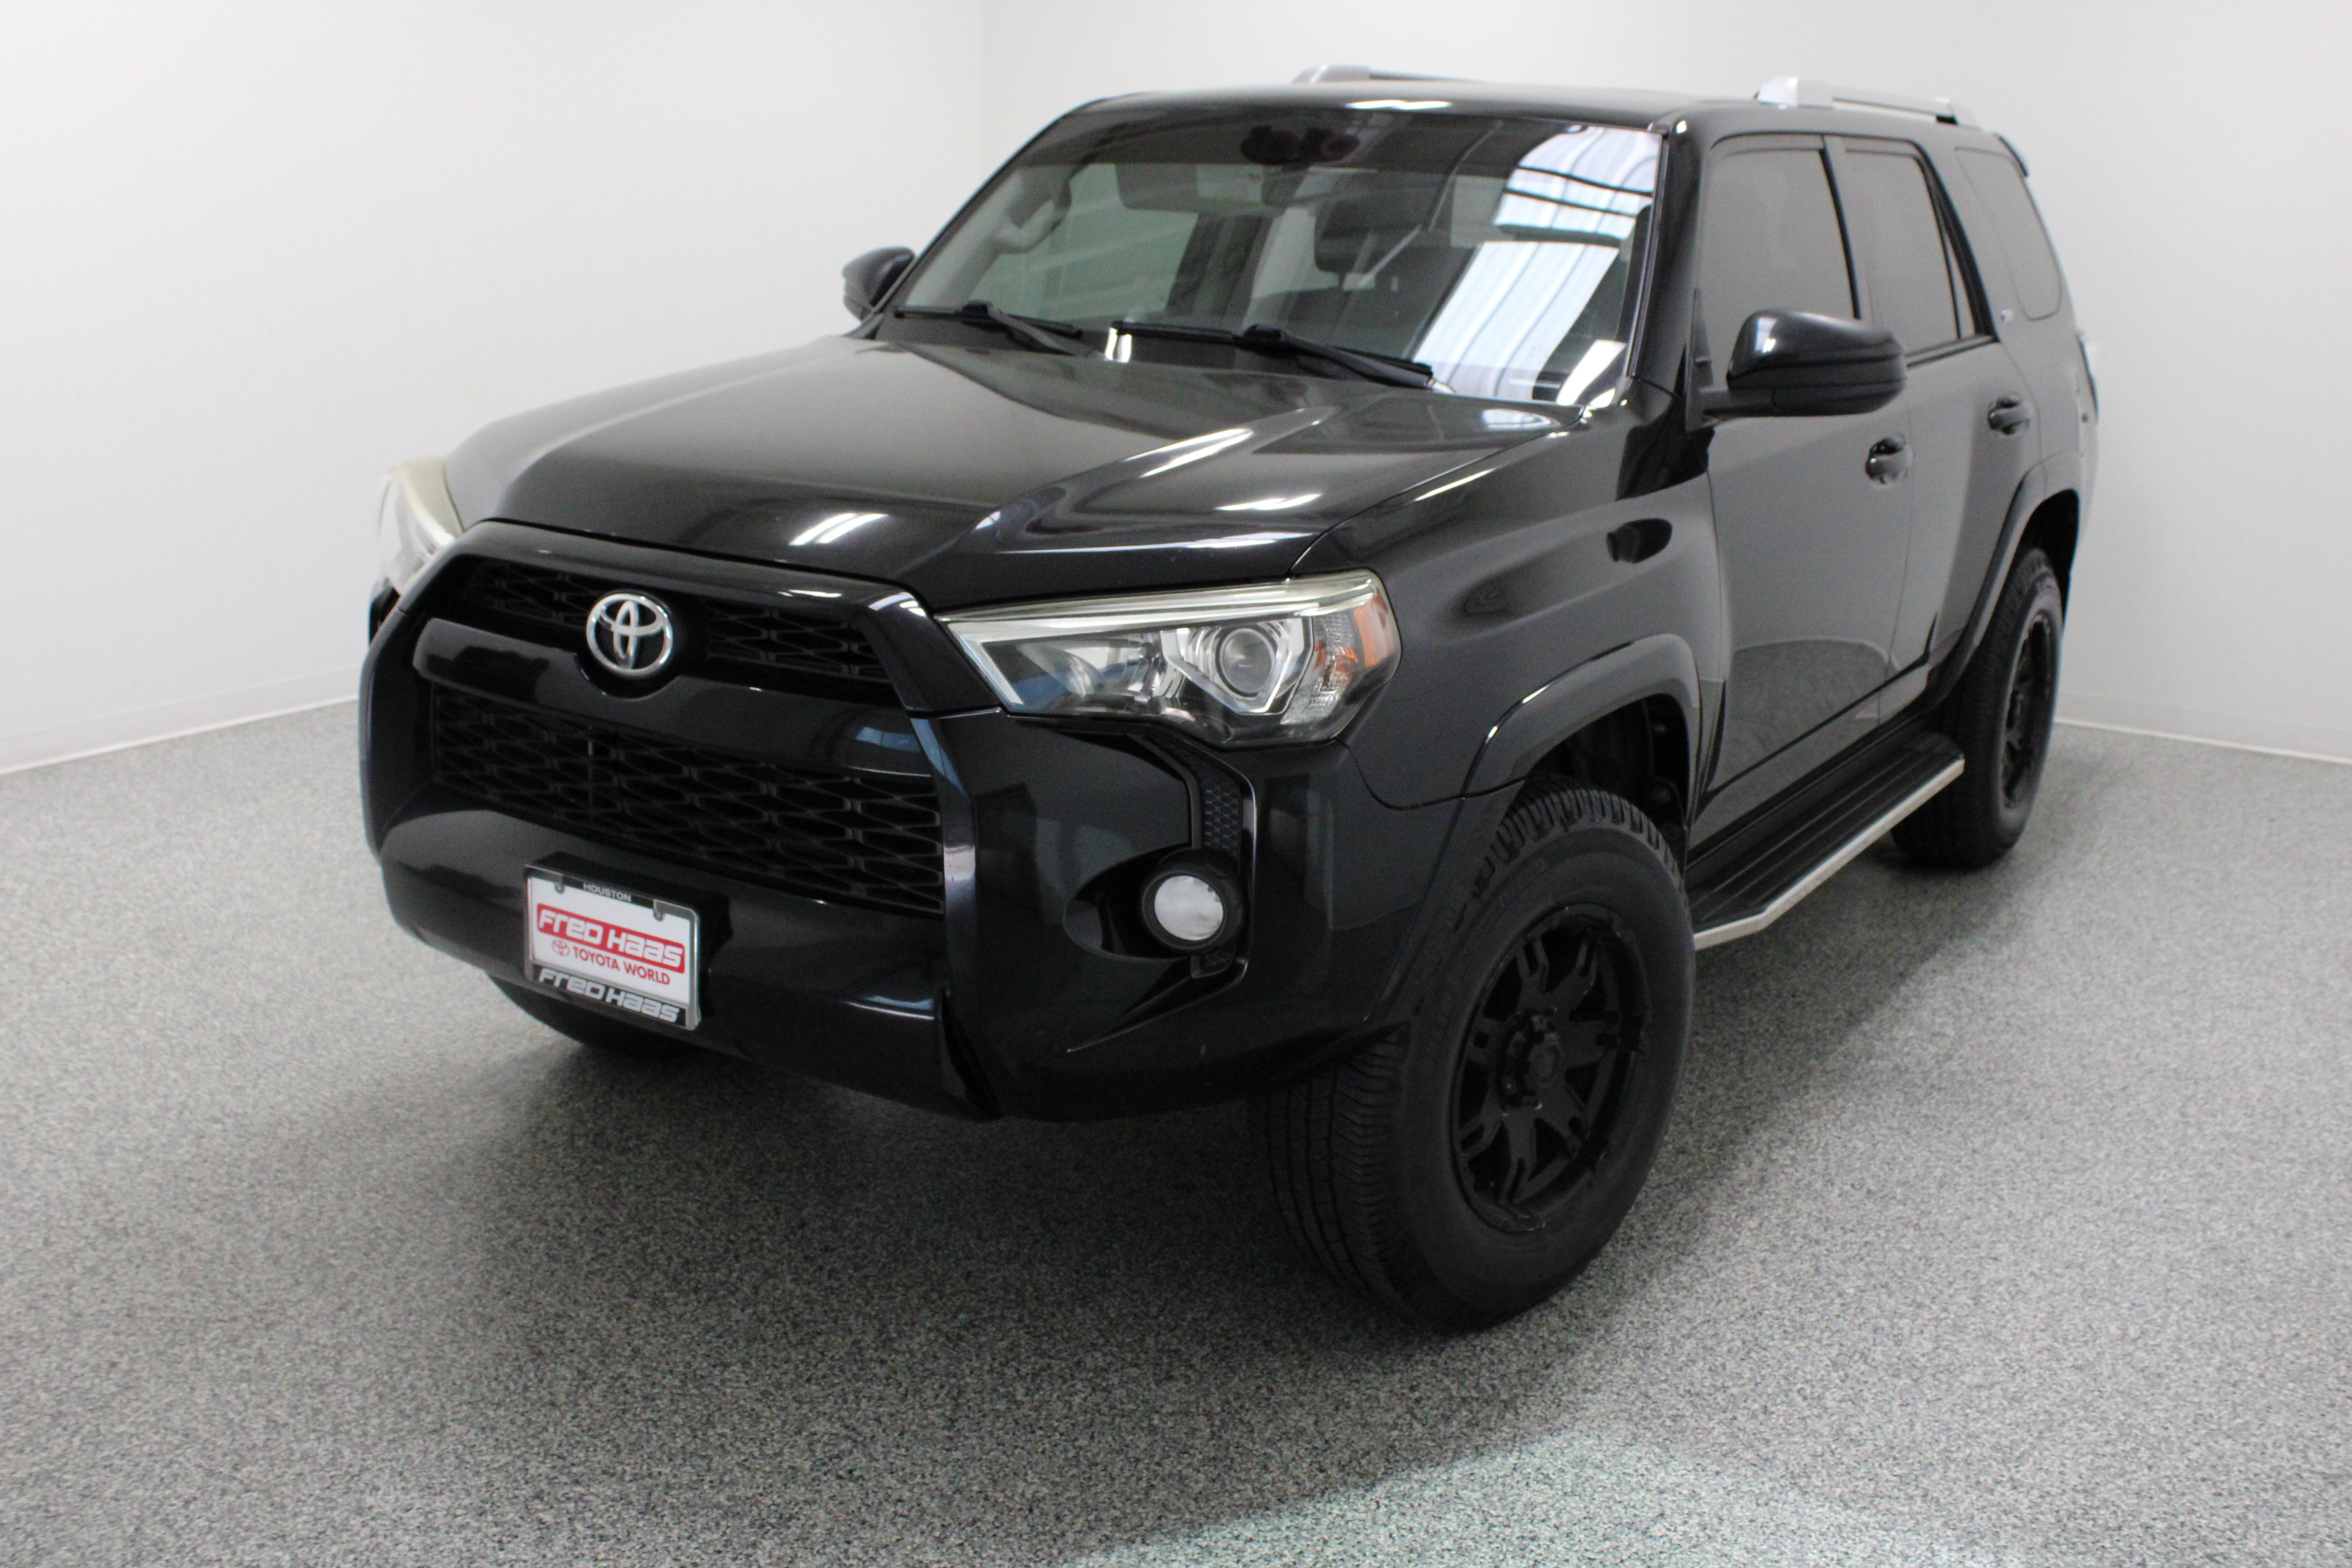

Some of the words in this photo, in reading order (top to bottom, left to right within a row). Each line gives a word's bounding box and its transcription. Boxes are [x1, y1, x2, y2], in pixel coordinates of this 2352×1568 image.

[583, 882, 632, 902] HOUSTON
[573, 946, 620, 971] TOYOTA
[624, 961, 670, 985] WORLD
